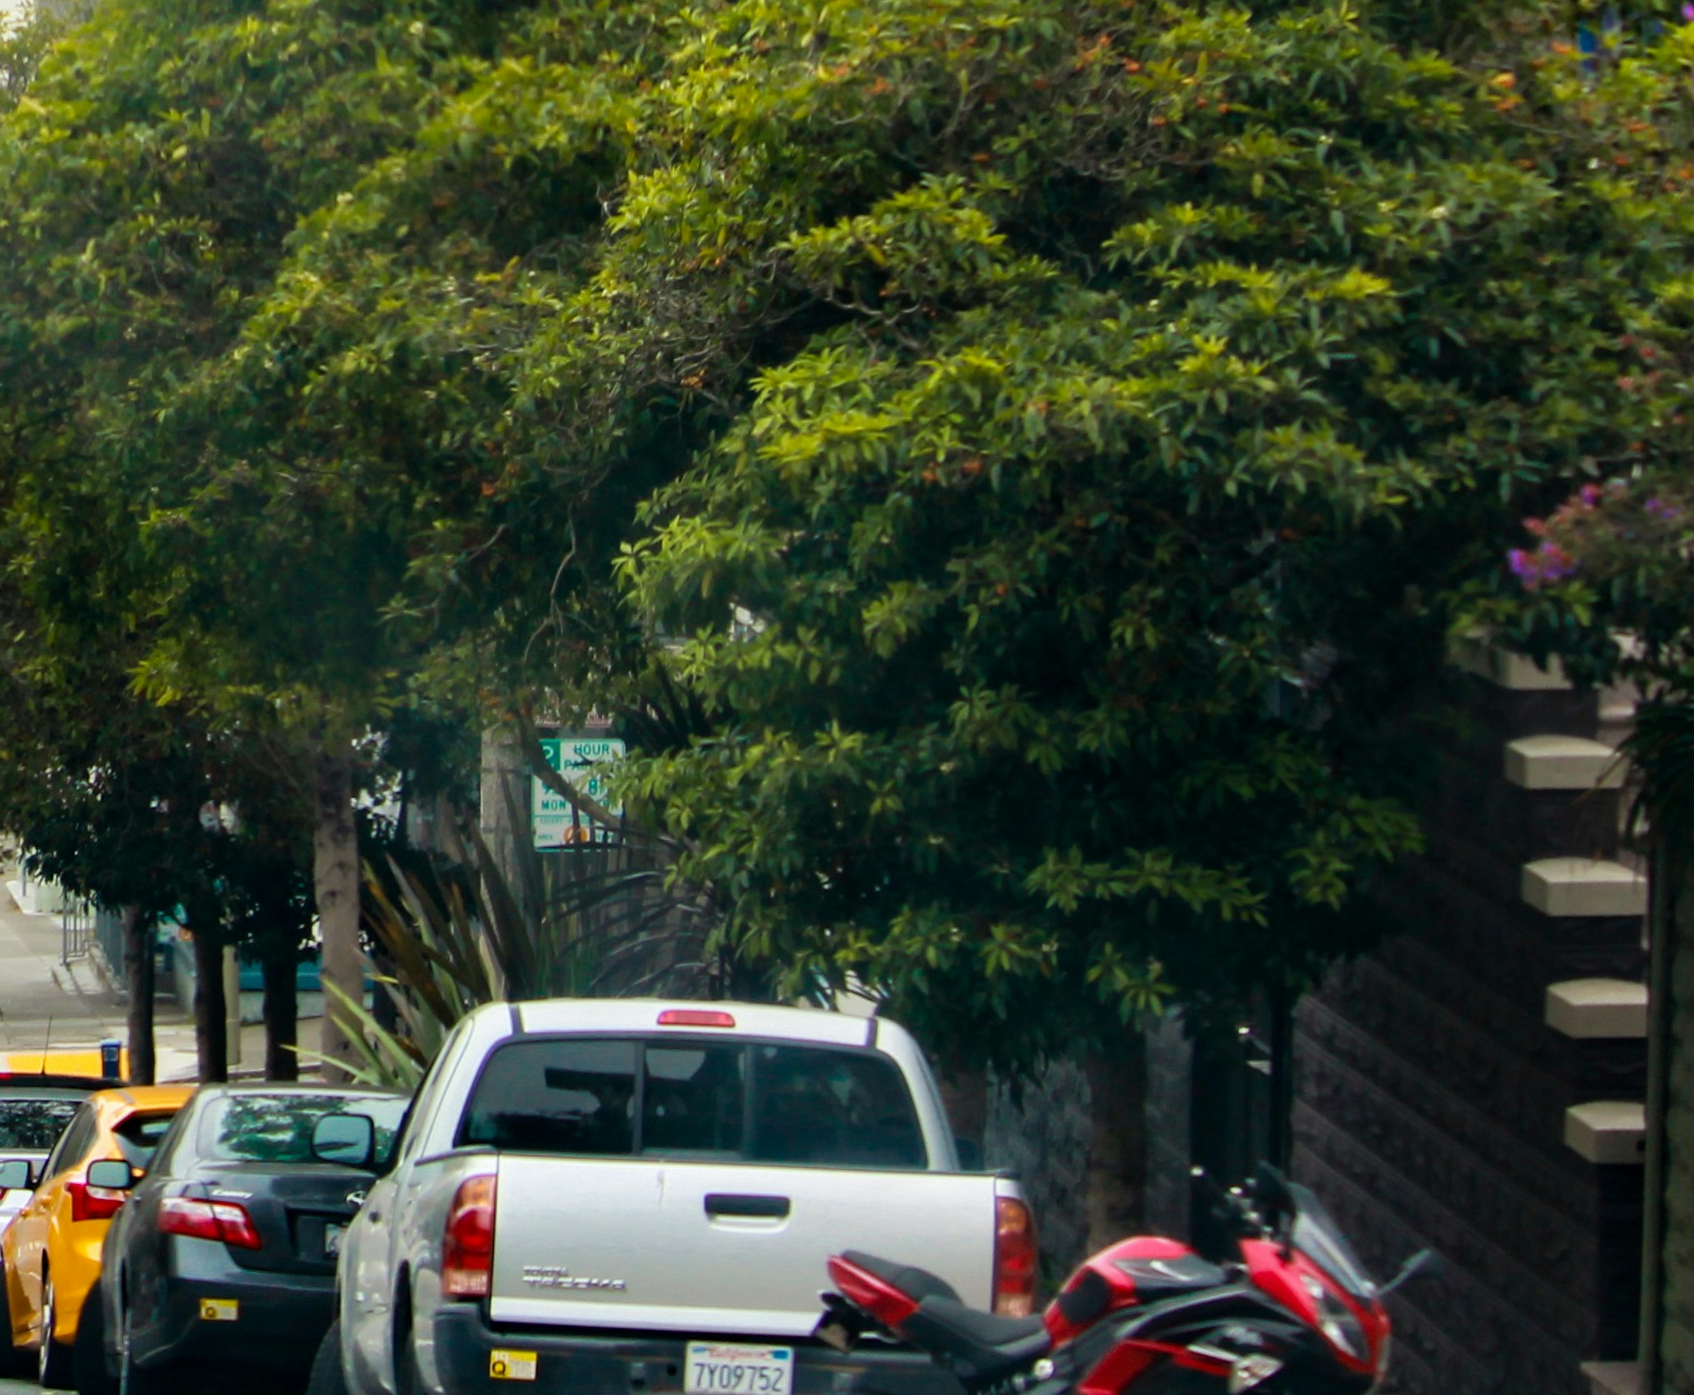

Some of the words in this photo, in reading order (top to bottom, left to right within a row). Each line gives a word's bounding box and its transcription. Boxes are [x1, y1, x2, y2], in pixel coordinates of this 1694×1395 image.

[574, 743, 610, 756] HOUR
[541, 800, 566, 810] MON
[491, 1360, 507, 1376] Q
[693, 1362, 783, 1393] 7Y09752
